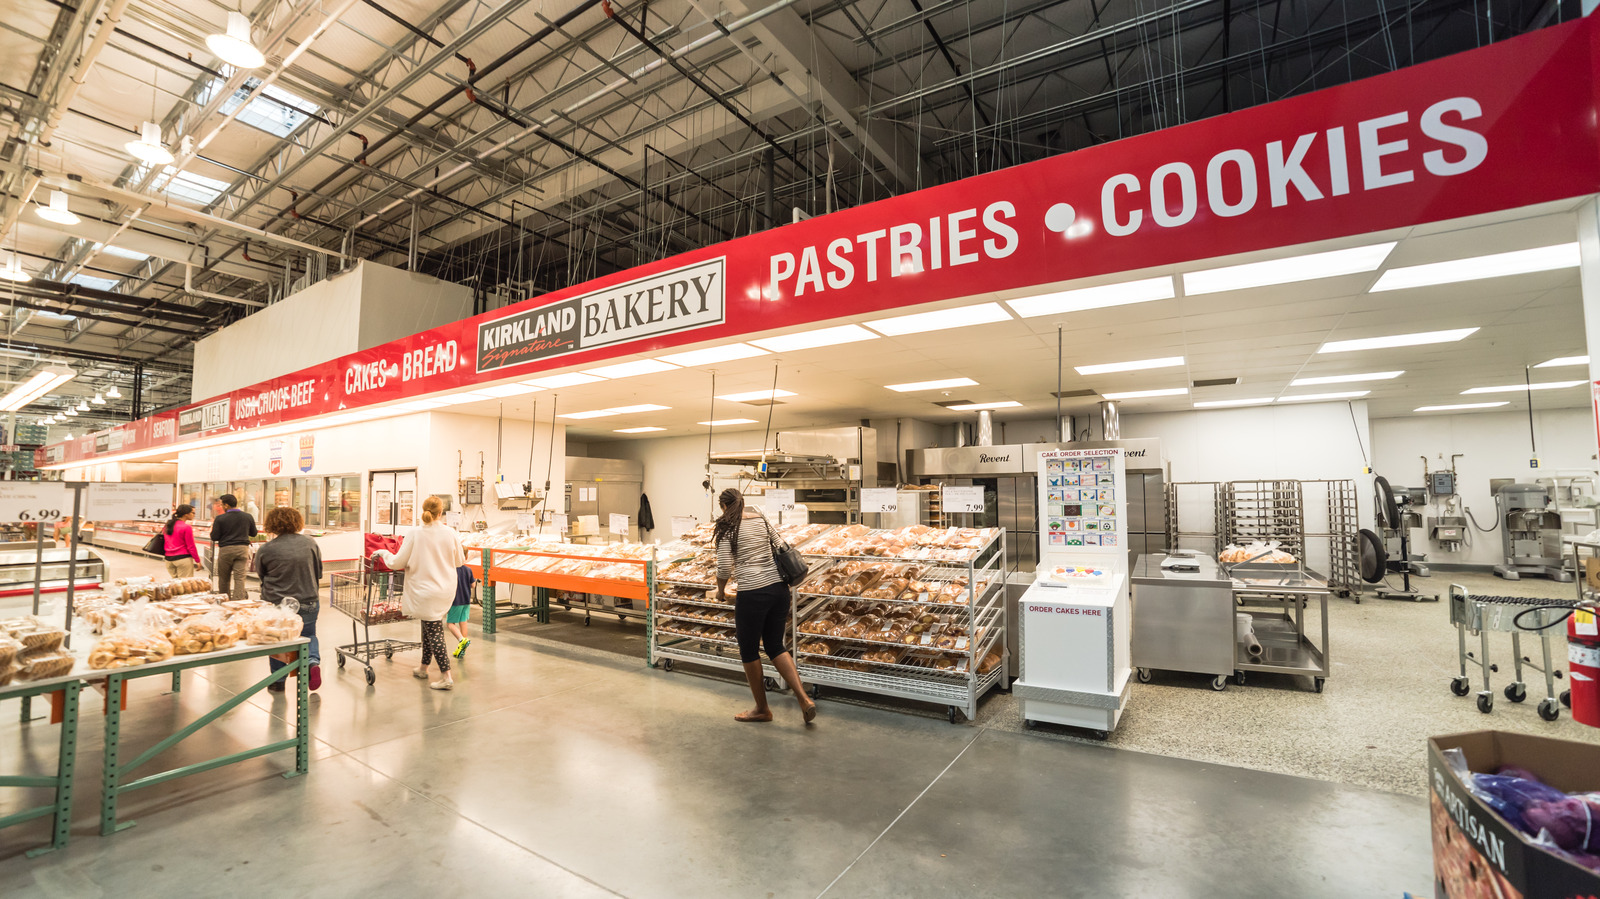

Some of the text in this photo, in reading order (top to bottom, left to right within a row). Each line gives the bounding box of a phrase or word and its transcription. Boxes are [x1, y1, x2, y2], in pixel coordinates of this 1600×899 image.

[769, 96, 1489, 302] PASTRIES COOKIES
[584, 272, 717, 339] BAKERY
[483, 306, 577, 351] KIRKLAND
[481, 337, 575, 369] Signature
[345, 340, 459, 396] CAKES BREAD
[257, 386, 289, 416] CHOICE
[291, 379, 315, 408] BEEF
[203, 402, 228, 429] MEAT
[153, 418, 175, 439] SEAFOOD
[979, 453, 1010, 464] Revent
[1124, 448, 1146, 458] vent
[18, 508, 60, 521] 6.99
[137, 508, 171, 519] 4.49
[781, 503, 795, 511] 7.99
[881, 503, 897, 512] 5.99
[966, 503, 984, 512] 7.99
[1029, 605, 1102, 617] ORDER CAKES HERE
[1445, 785, 1506, 872] ARTISAN
